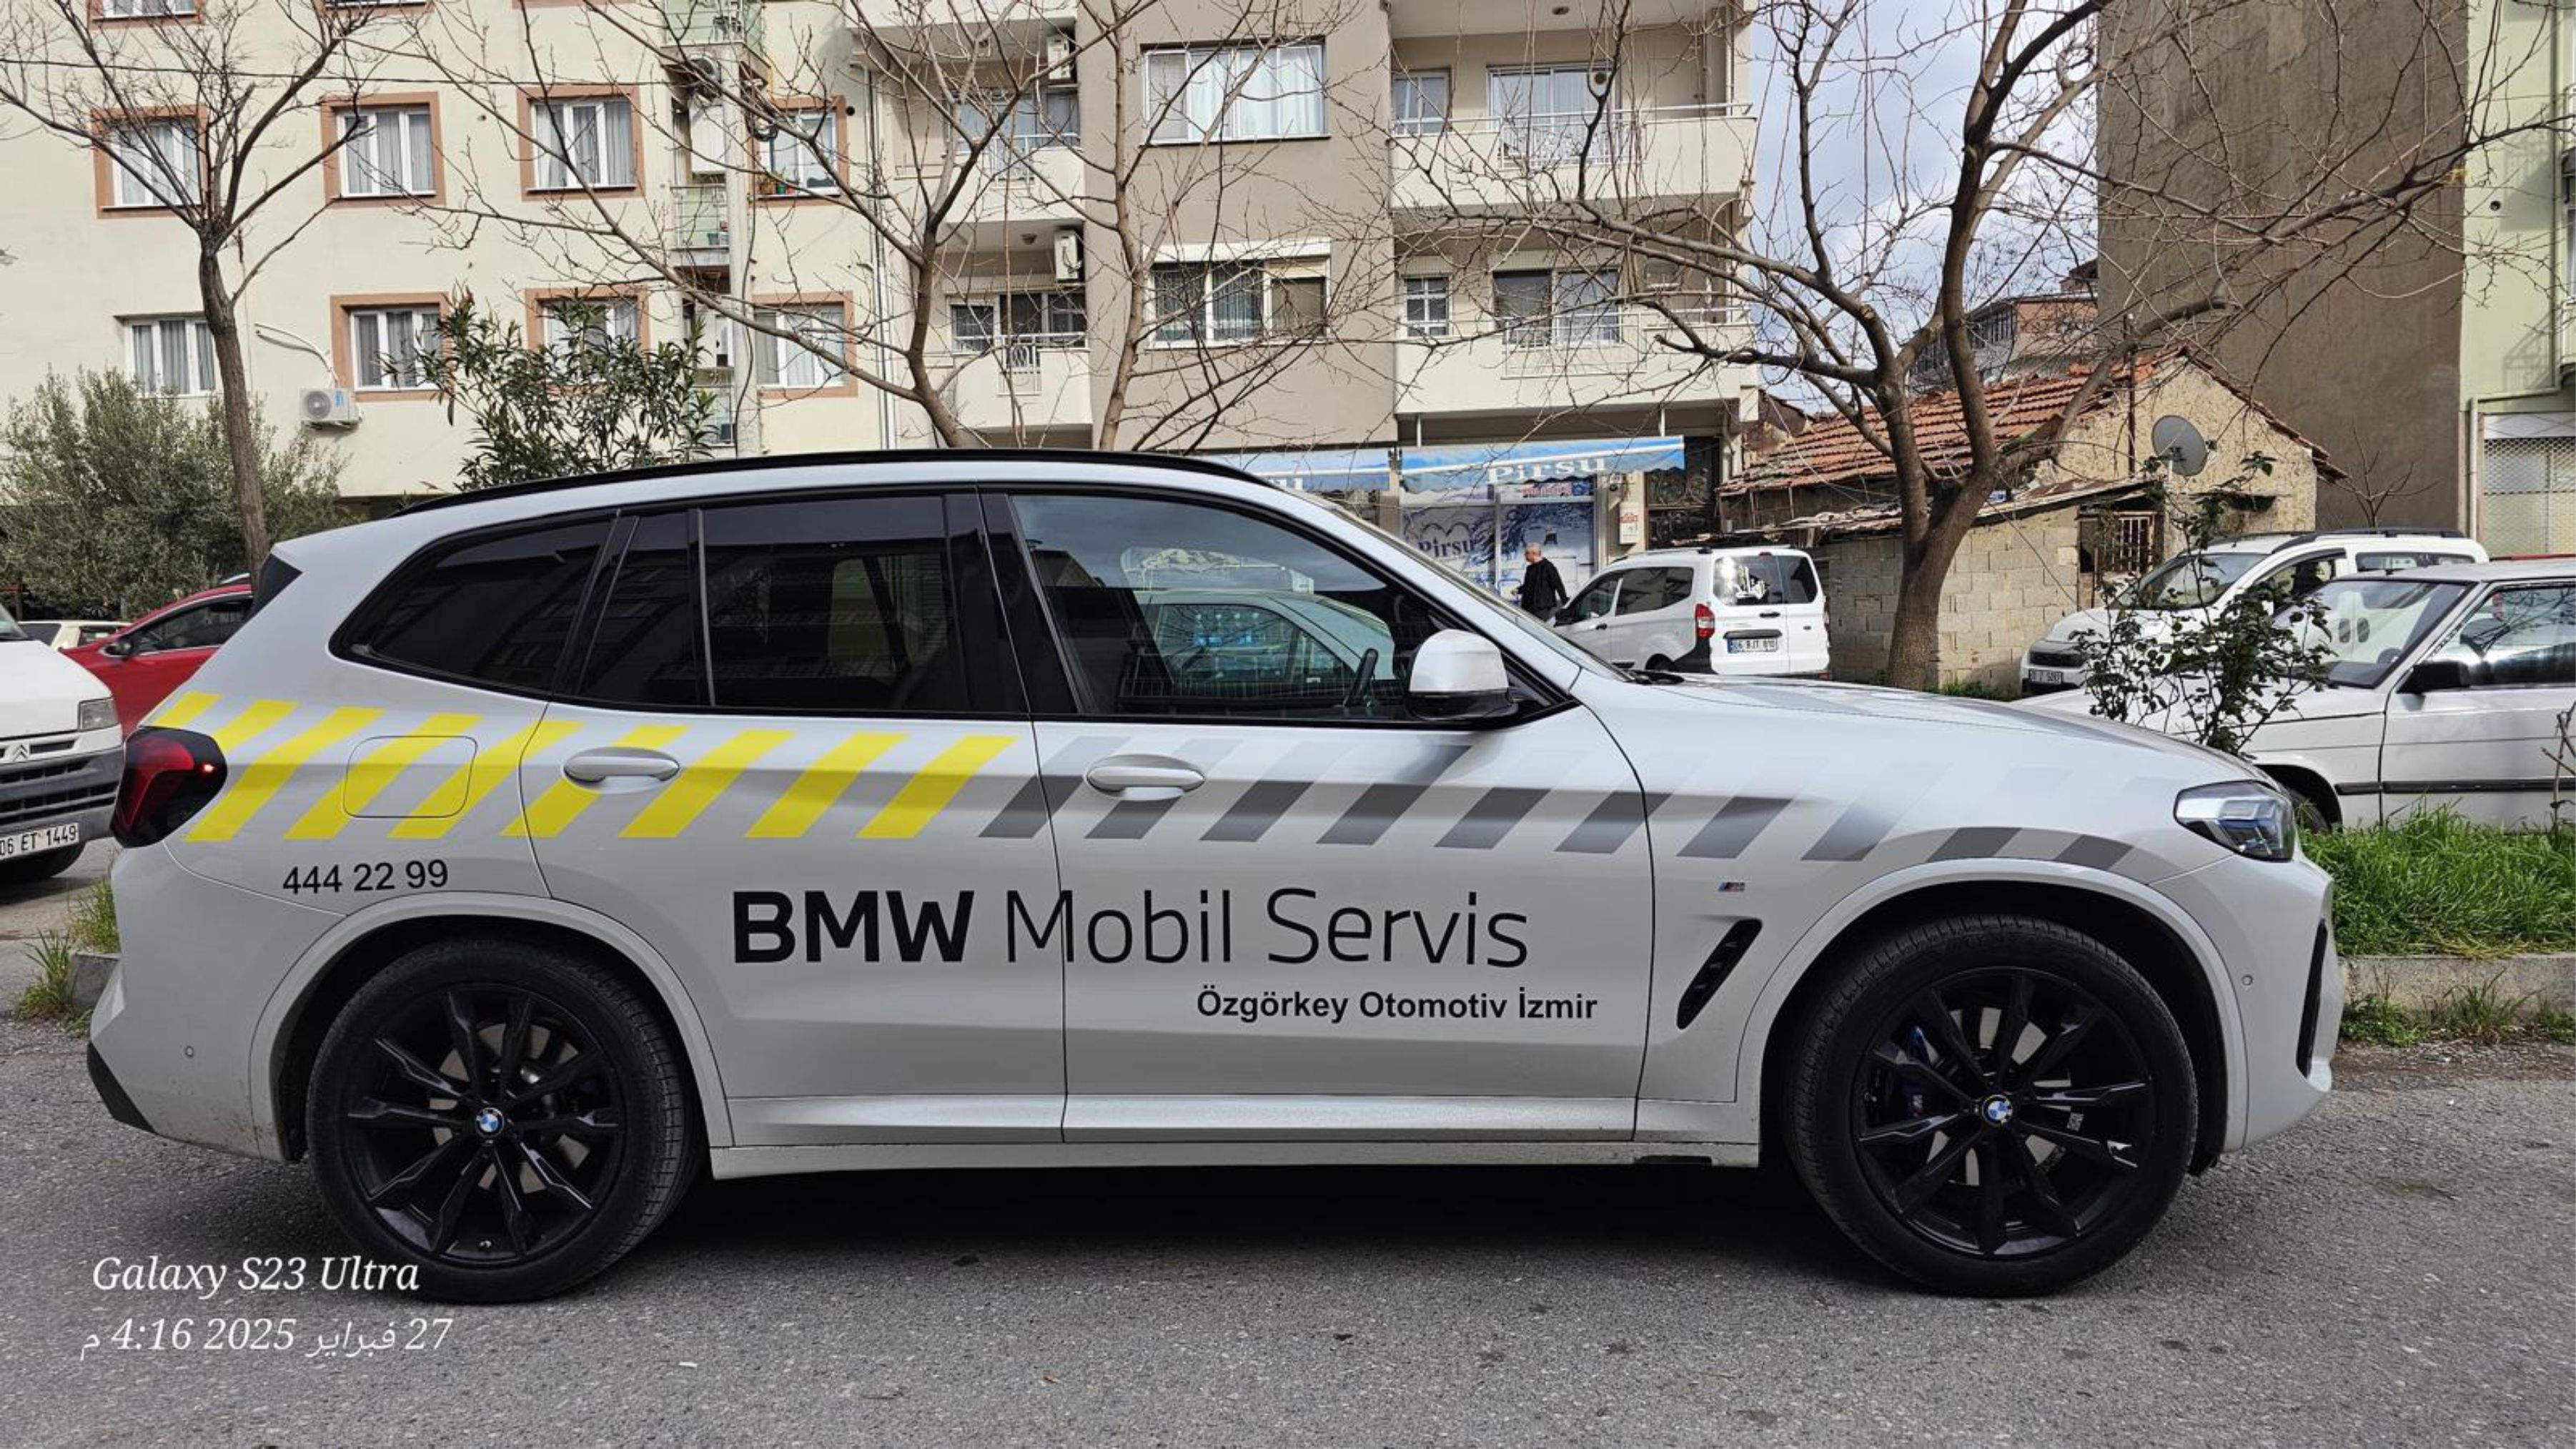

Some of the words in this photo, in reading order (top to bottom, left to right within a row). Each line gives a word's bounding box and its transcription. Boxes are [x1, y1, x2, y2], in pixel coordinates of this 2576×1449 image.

[1487, 458, 1607, 484] Pirsu
[21, 831, 38, 851] ET
[46, 825, 76, 846] 1449
[282, 865, 343, 895] 444
[353, 862, 395, 892] 22
[405, 859, 449, 889] 99
[733, 890, 975, 964] BMW
[1006, 889, 1232, 963] Mobil
[1267, 887, 1528, 969] Servis
[1197, 984, 1349, 1024] Özgörkey
[1359, 990, 1507, 1019] Otomotiv
[1519, 986, 1598, 1019] İzmir
